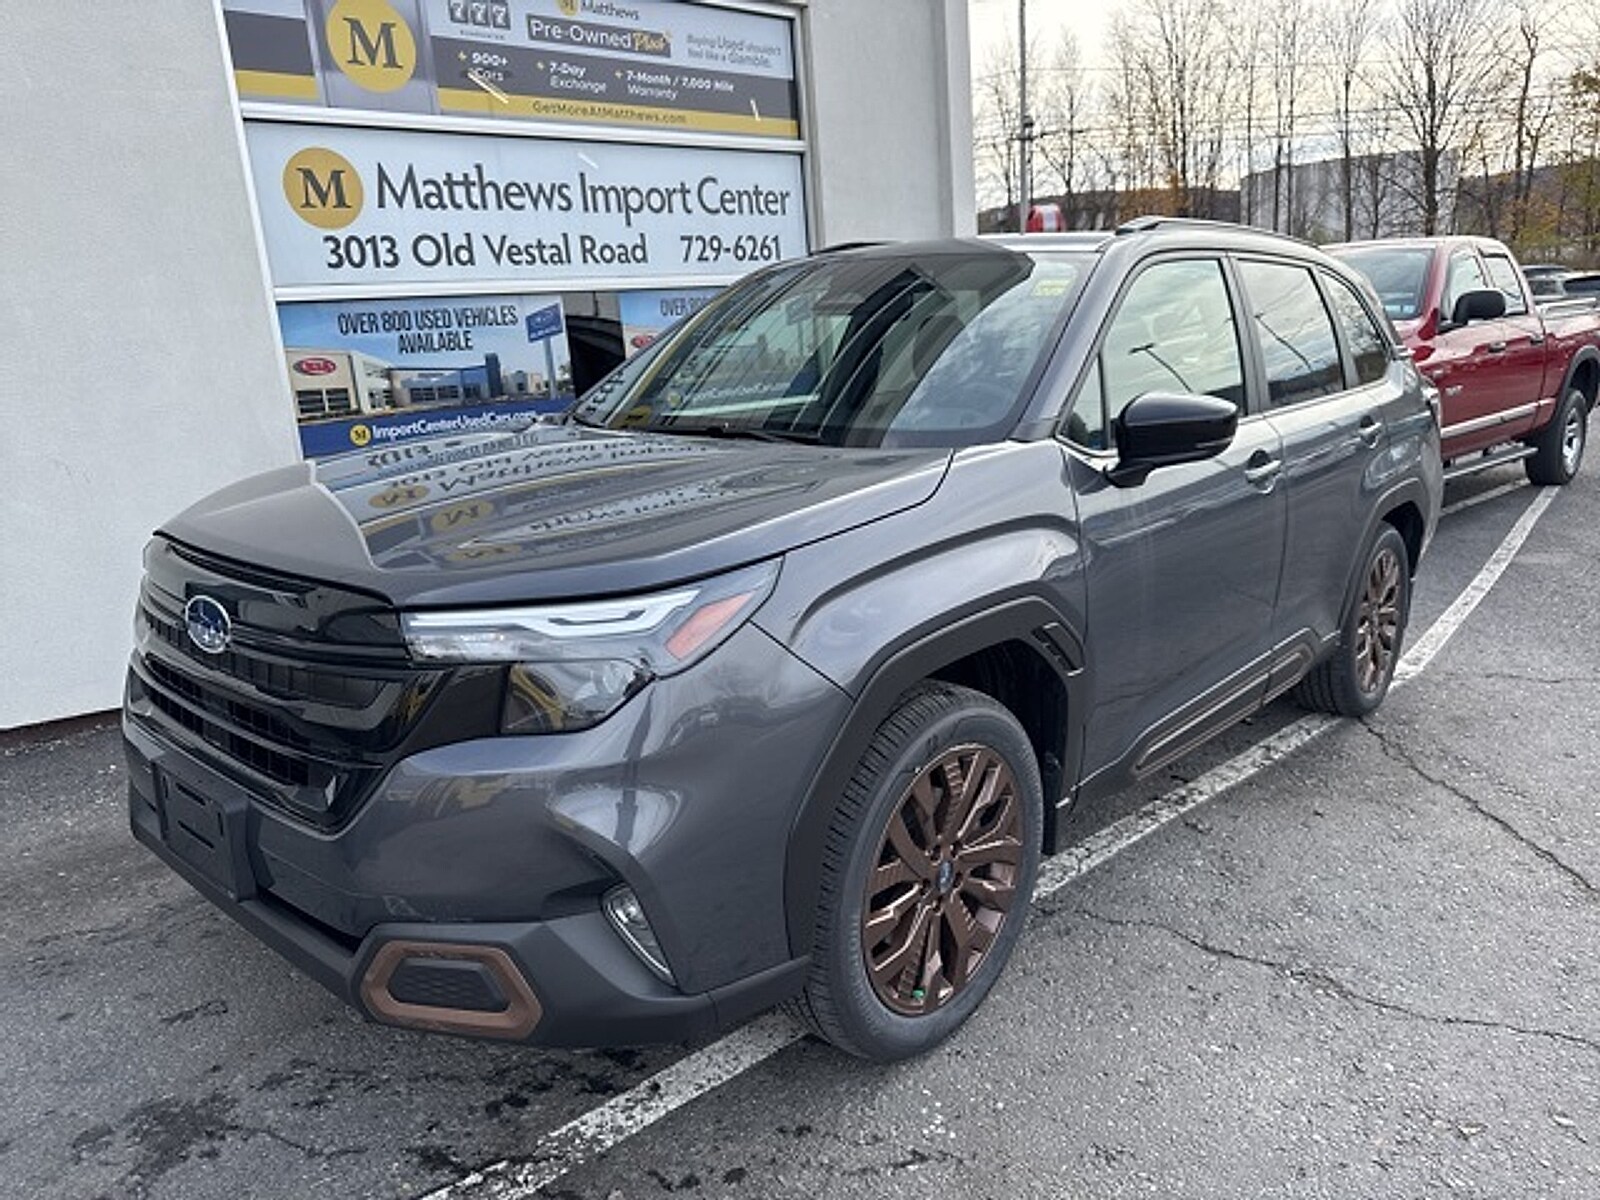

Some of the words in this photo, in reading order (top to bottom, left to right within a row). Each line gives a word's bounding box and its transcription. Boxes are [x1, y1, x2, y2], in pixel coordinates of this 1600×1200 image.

[581, 0, 639, 21] Matthews
[343, 17, 403, 69] M
[530, 19, 632, 48] Pre-Owned
[550, 62, 586, 78] 7-Day
[626, 70, 671, 86] 7-Month
[550, 75, 606, 93] Exchange
[627, 85, 678, 100] Warranty
[296, 167, 351, 209] M
[377, 162, 572, 212] Matthews
[579, 172, 692, 228] Import
[697, 176, 790, 216] Center
[324, 235, 400, 269] 3013
[412, 233, 475, 267] Old
[482, 233, 571, 266] Vestal
[580, 233, 648, 264] Road
[680, 235, 781, 262] 729-6261
[338, 312, 378, 336] OVER
[381, 309, 412, 333] 800
[415, 307, 452, 330] USED
[453, 305, 518, 329] VEHICLES
[399, 330, 473, 354] AVAILABLE
[372, 411, 537, 441] ImportCenterUsedCars.com
